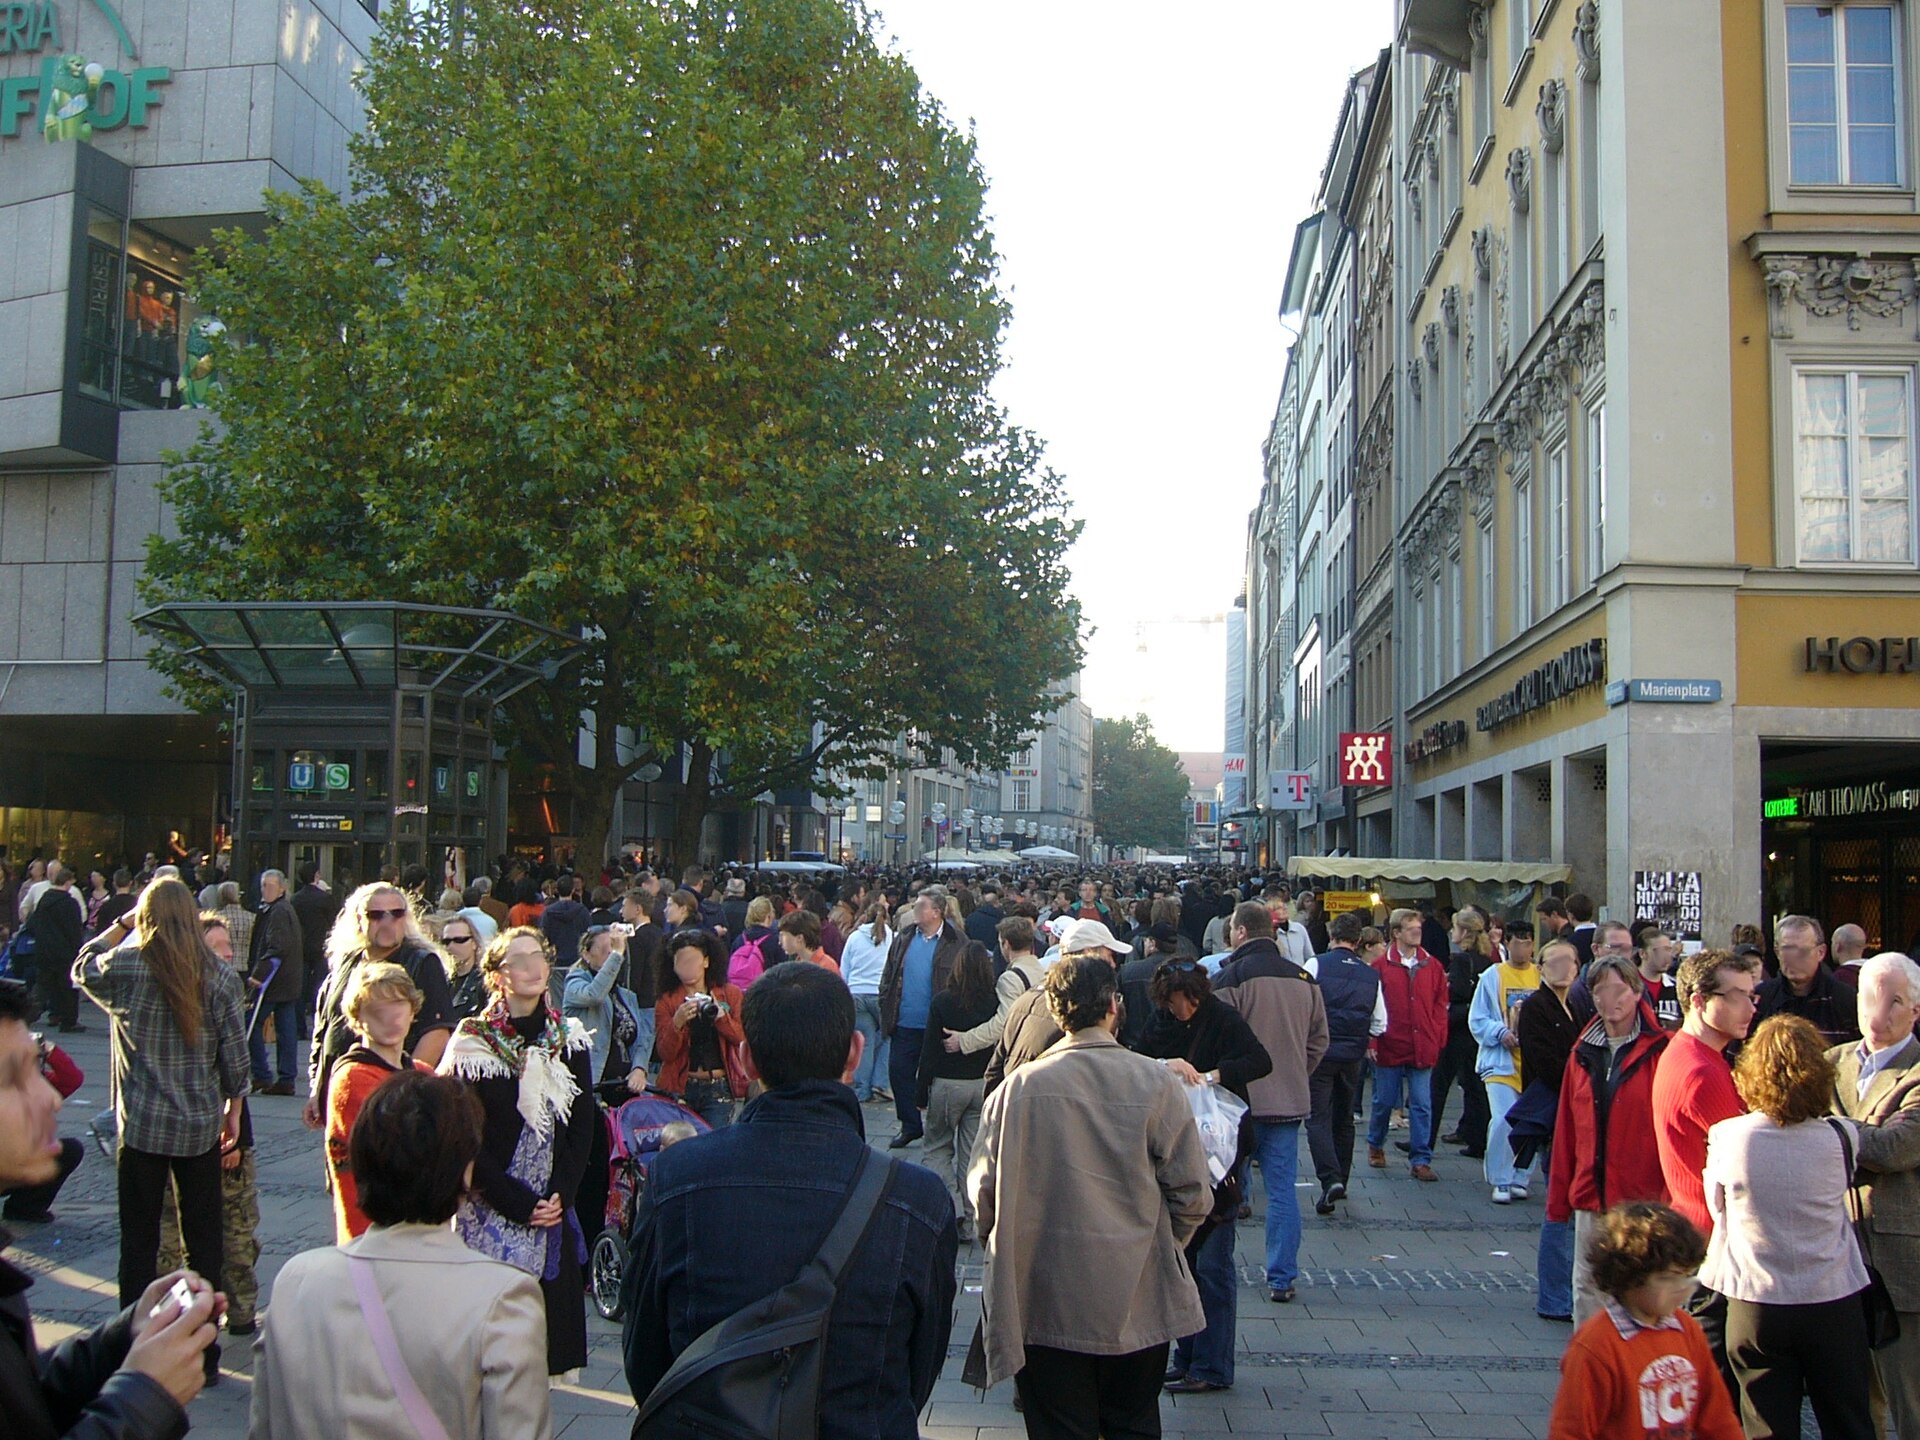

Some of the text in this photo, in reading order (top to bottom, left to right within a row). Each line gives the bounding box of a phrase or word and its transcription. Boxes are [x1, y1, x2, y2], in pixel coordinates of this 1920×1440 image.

[1513, 669, 1541, 715] CARL
[1540, 639, 1603, 704] THOMASS
[1640, 681, 1711, 699] Marienplatz
[294, 766, 346, 787] U S
[1802, 789, 1827, 817] CARL
[1830, 781, 1887, 815] THOMASS
